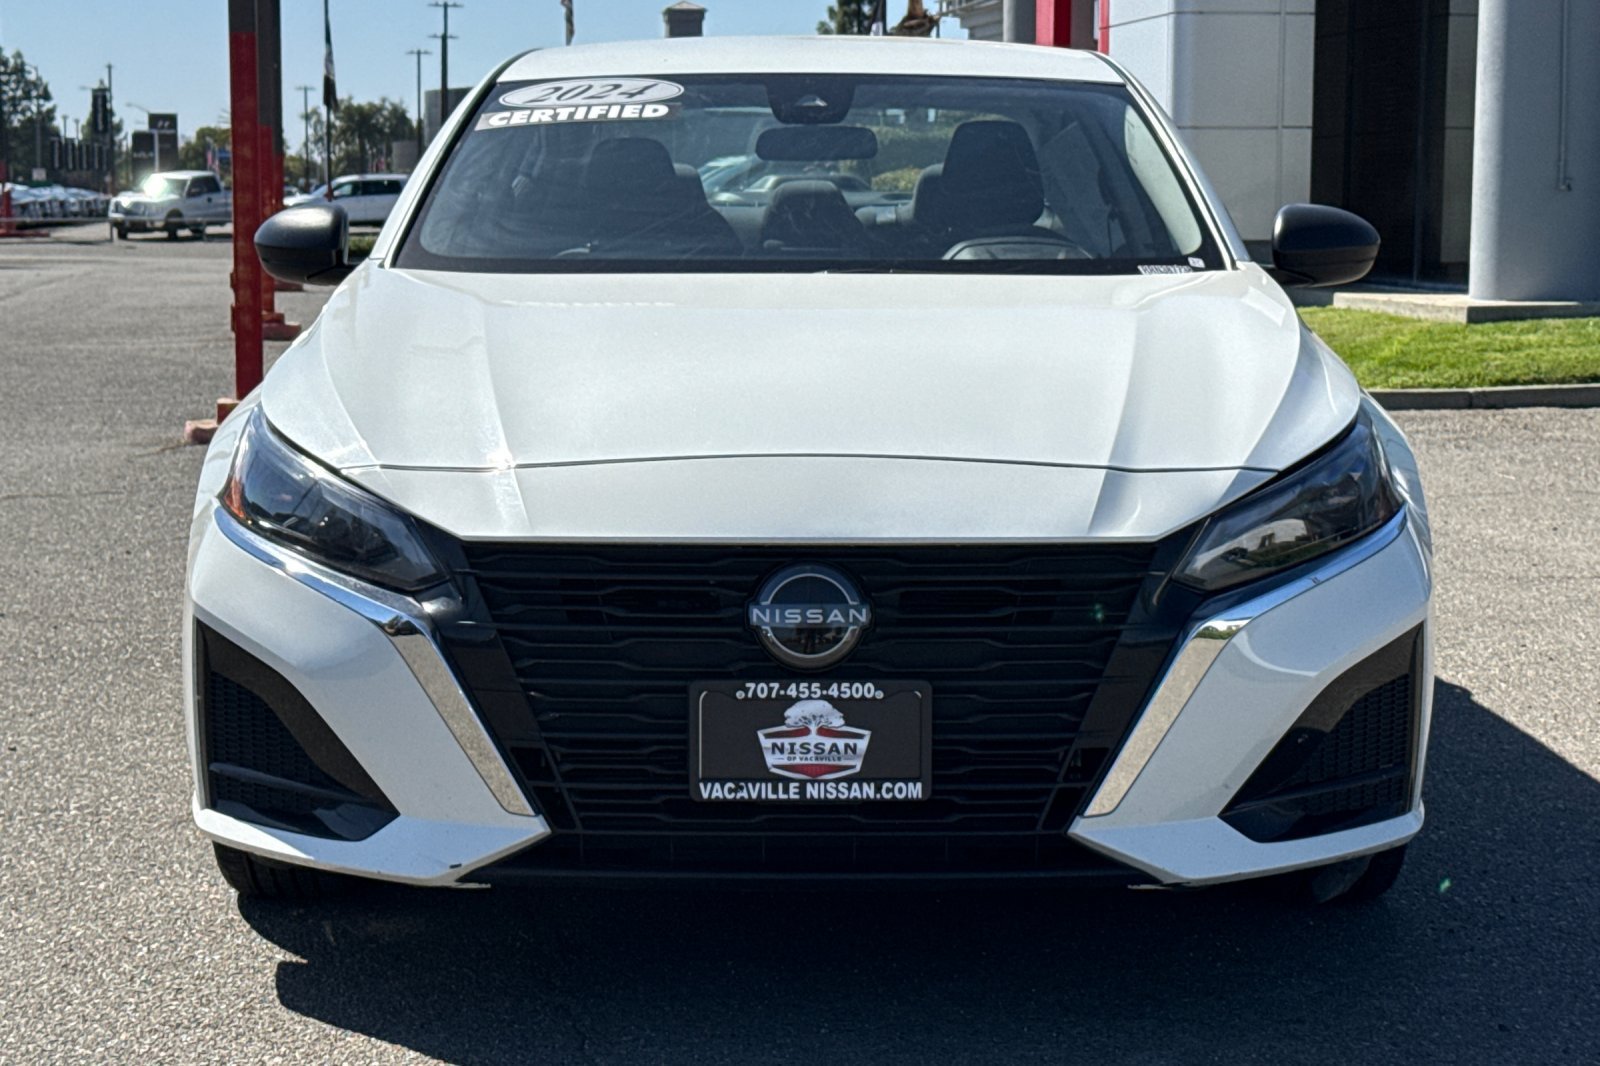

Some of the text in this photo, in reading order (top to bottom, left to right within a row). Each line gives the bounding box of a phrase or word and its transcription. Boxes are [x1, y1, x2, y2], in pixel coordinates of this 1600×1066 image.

[524, 83, 659, 103] 2024
[488, 104, 669, 127] CERTIFIED
[752, 608, 867, 623] NISSAN
[745, 682, 875, 699] 707-455-4500
[771, 742, 858, 755] NISSAN
[806, 782, 922, 799] NISSAN.COM
